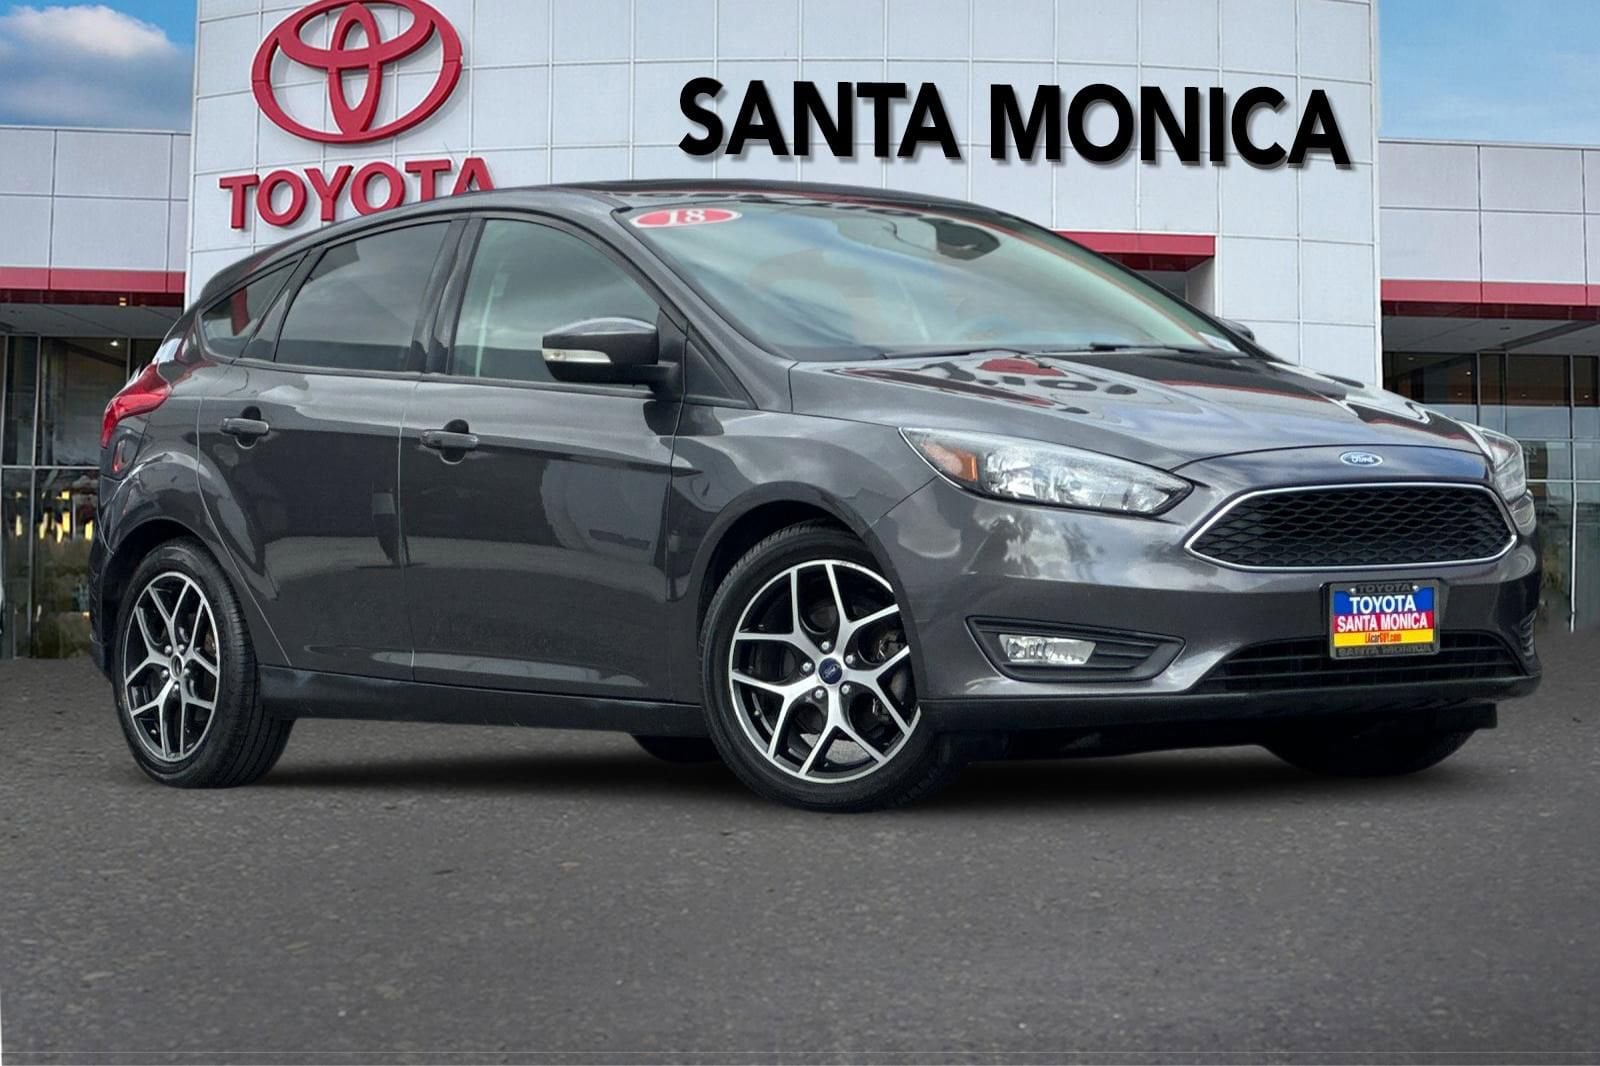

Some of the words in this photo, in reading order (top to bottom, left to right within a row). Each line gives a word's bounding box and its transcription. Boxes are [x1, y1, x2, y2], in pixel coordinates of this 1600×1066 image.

[679, 77, 961, 158] SANTA
[990, 84, 1351, 168] MONICA
[218, 157, 494, 229] TOYOTA
[668, 208, 706, 225] 18
[1358, 584, 1411, 593] TOYOTA
[1350, 595, 1417, 614] TOYOTA
[1337, 614, 1379, 632] SANTA
[1381, 612, 1428, 630] MONICA
